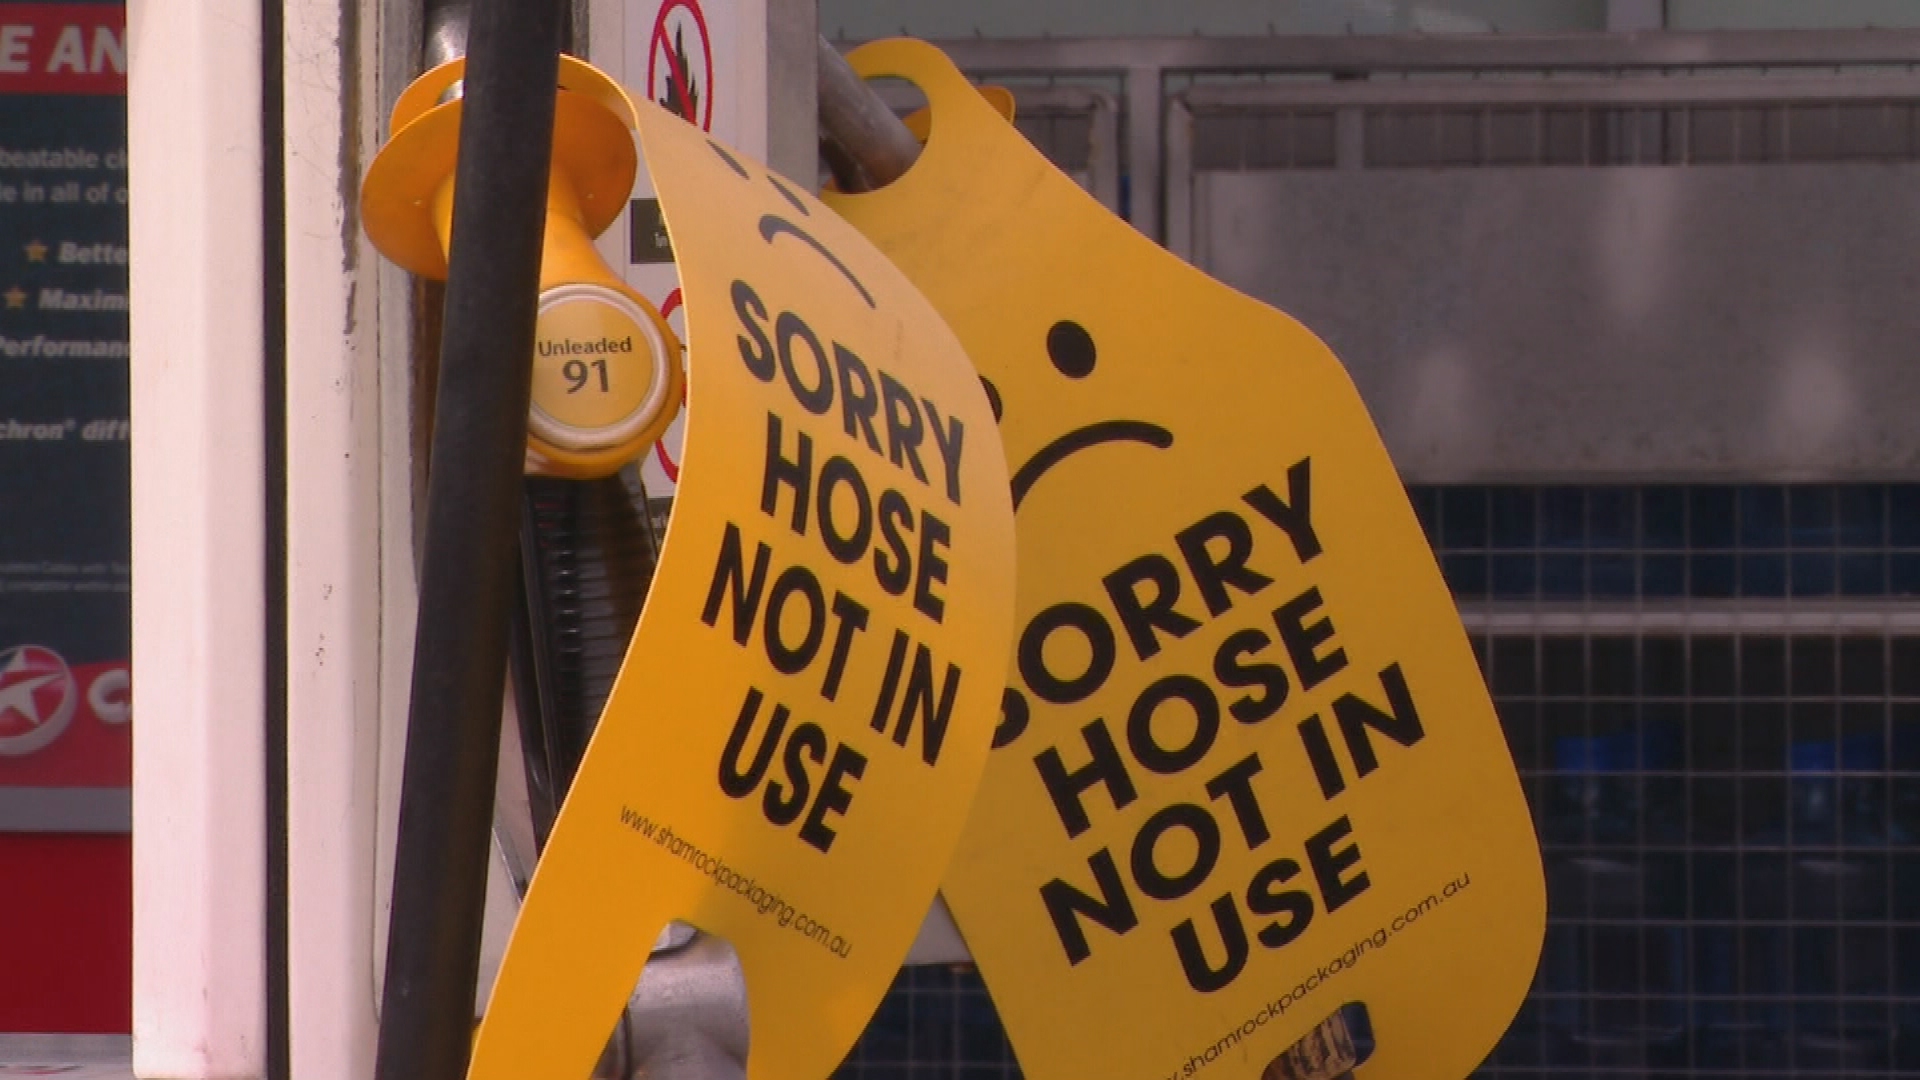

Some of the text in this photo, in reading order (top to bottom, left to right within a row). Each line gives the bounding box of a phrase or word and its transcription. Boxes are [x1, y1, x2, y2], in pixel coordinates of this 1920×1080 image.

[23, 180, 44, 202] in
[51, 180, 79, 202] all
[85, 180, 110, 202] of
[538, 335, 633, 357] Unleaded
[562, 359, 609, 394] 91
[730, 279, 964, 507] SORRY
[760, 410, 951, 625] HOSE
[700, 520, 962, 768] NOT IN
[1033, 585, 1349, 840] HOSE
[717, 685, 868, 855] USE
[1039, 661, 1426, 967] NOT IN
[620, 805, 852, 959] www.shamrockpackaging.com.au
[1169, 814, 1371, 994] USE
